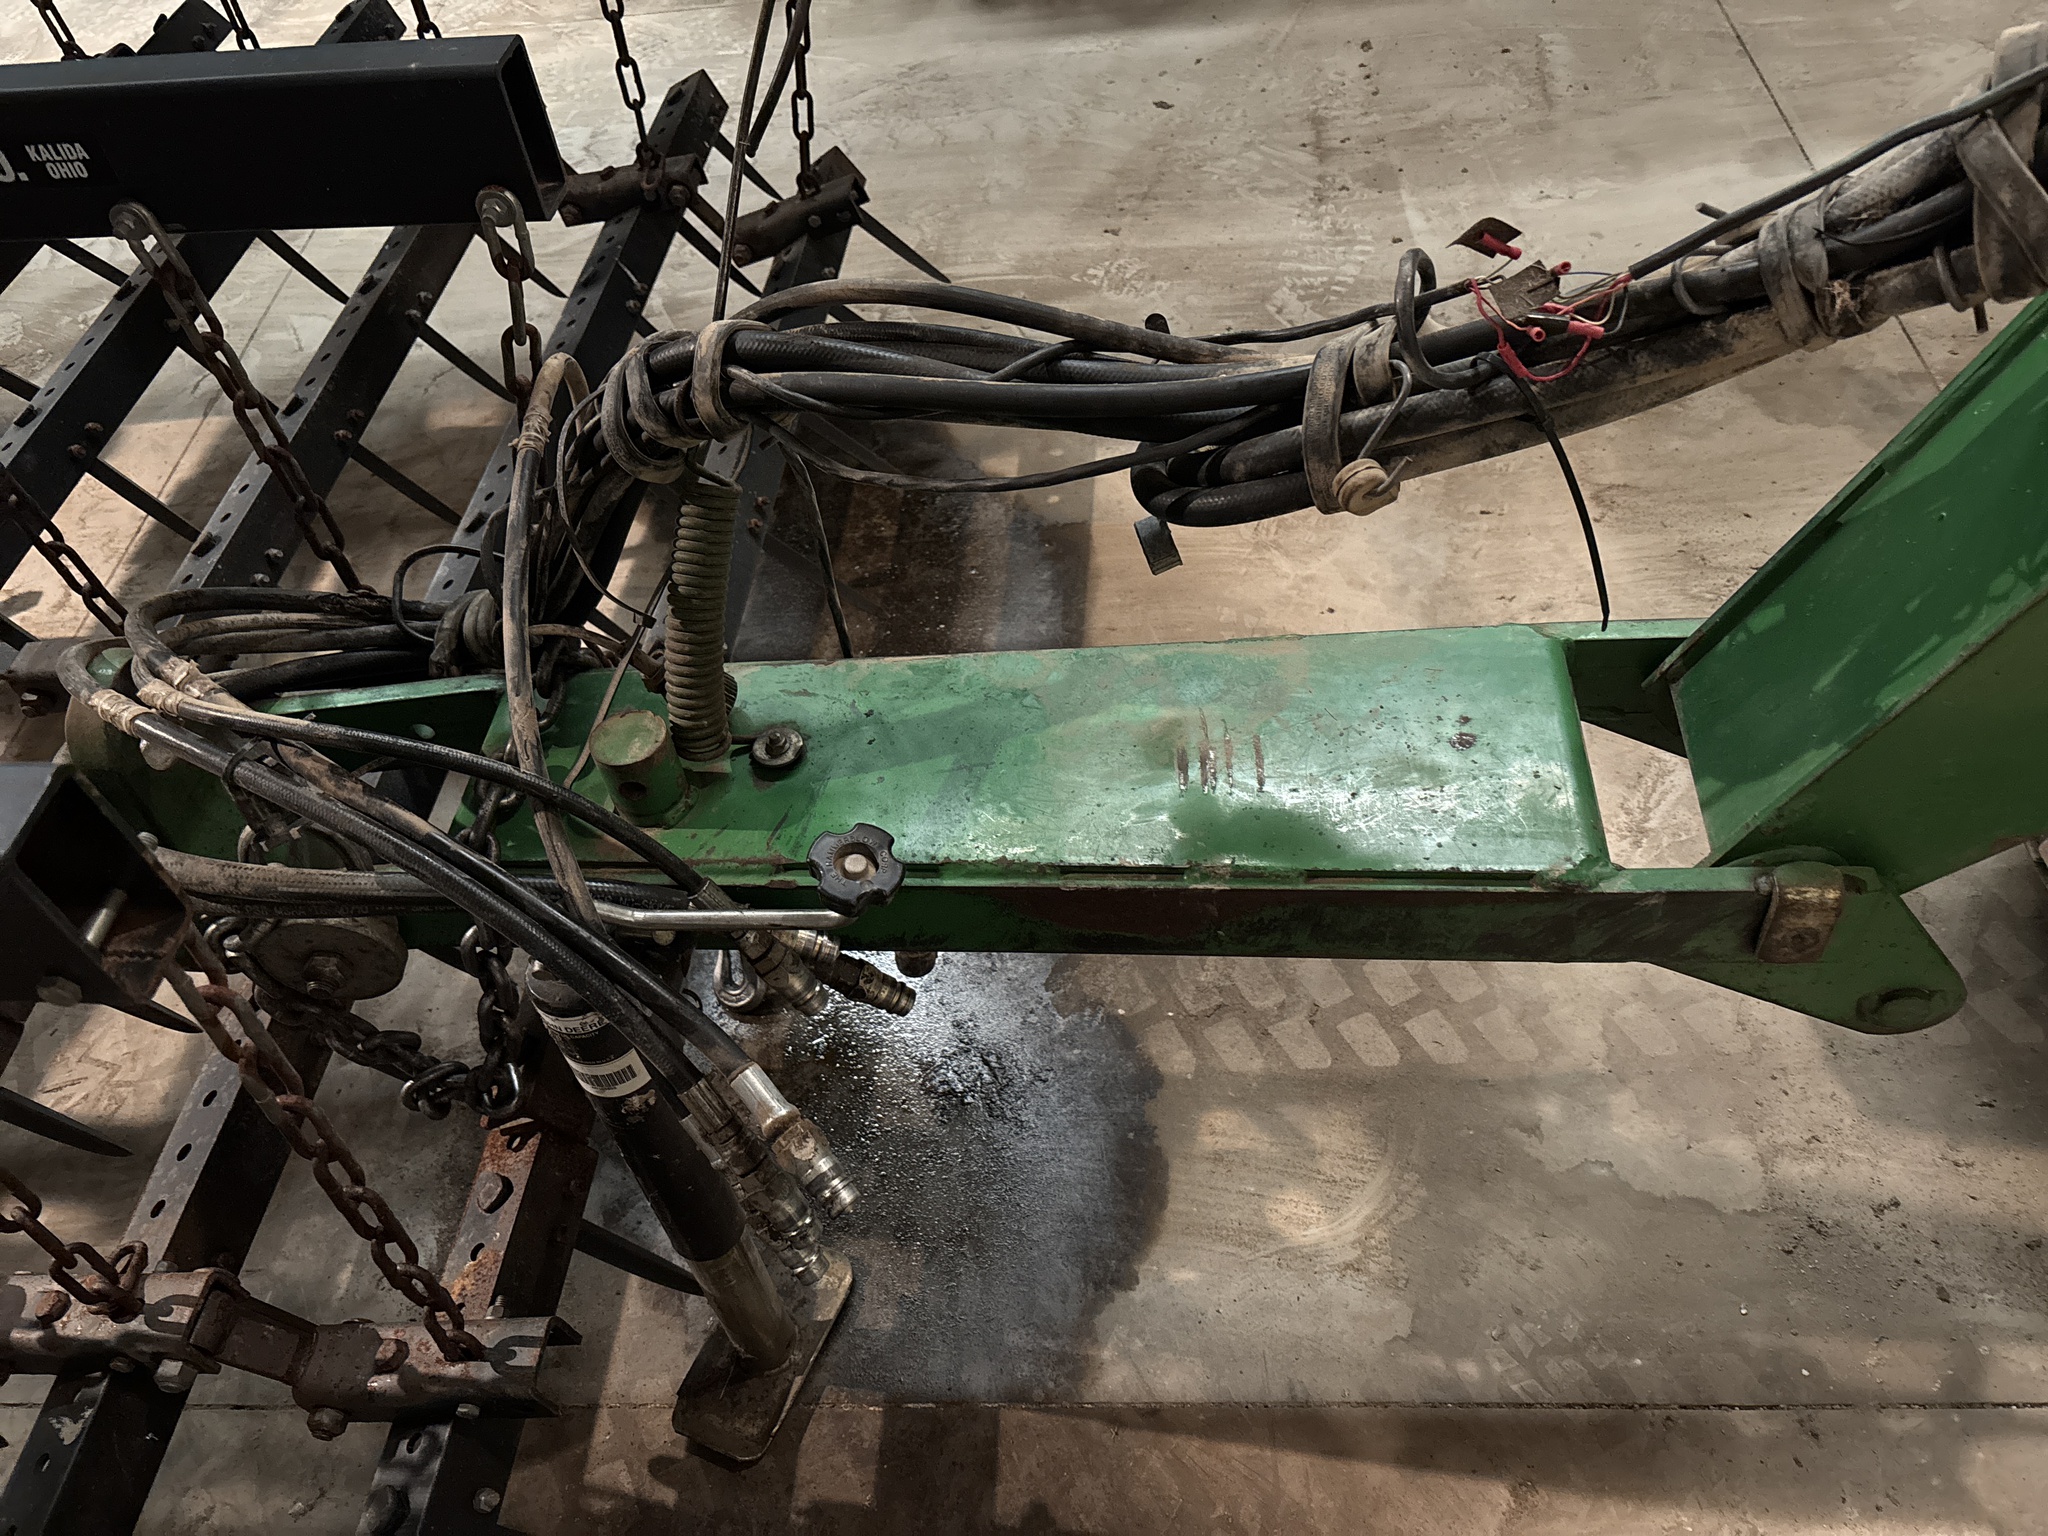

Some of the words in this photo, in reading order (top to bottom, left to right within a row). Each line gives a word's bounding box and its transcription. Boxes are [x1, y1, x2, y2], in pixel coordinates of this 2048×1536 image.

[24, 143, 90, 162] KALIDA
[45, 161, 88, 179] OHIO
[830, 872, 846, 887] THE
